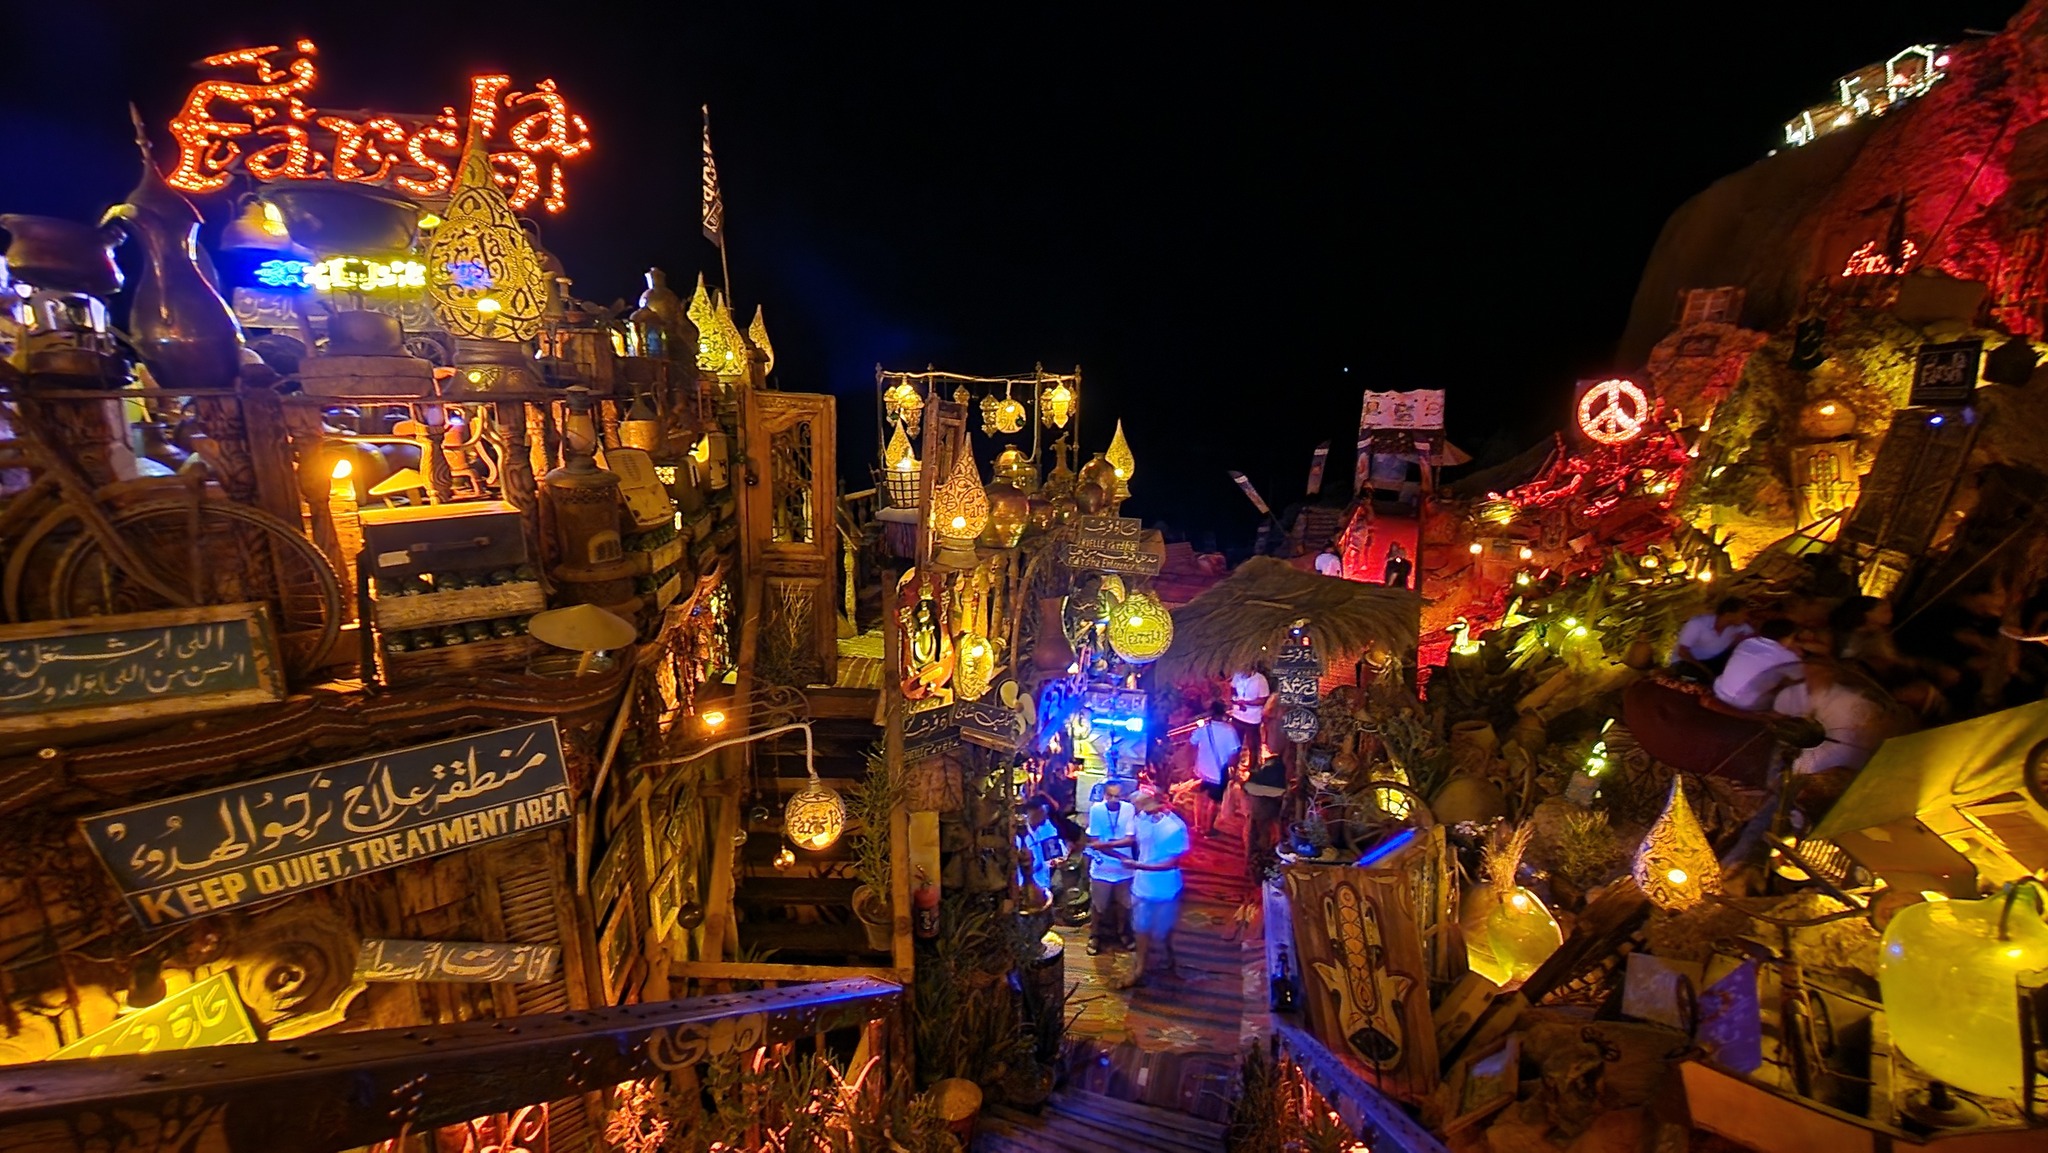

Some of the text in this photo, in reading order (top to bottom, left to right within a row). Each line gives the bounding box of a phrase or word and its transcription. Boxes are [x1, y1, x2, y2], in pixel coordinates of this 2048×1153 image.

[137, 871, 248, 925] KEEP
[348, 805, 510, 872] TREATMENT
[514, 791, 571, 832] AREA
